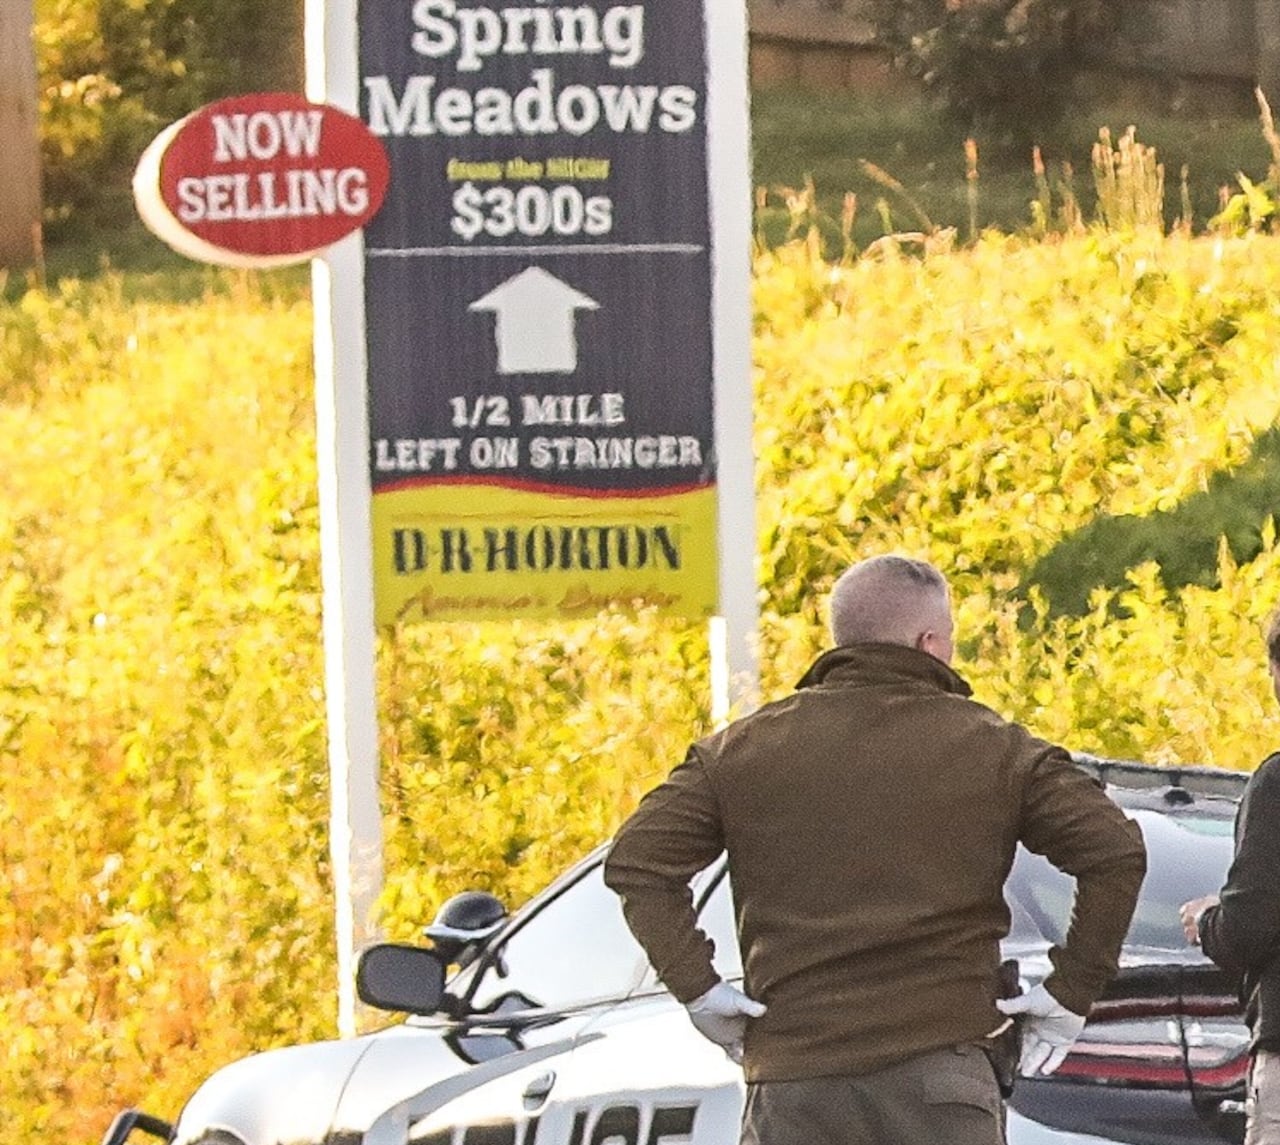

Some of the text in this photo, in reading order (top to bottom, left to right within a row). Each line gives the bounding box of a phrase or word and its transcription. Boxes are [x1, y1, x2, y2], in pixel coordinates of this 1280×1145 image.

[411, 0, 646, 71] Spring
[364, 67, 698, 137] Meadows
[213, 111, 324, 164] NOW
[177, 168, 370, 222] SELLING
[451, 181, 613, 241] $300s
[451, 392, 627, 429] 1/2 MILE
[375, 435, 703, 472] LEFT ON STRINGER
